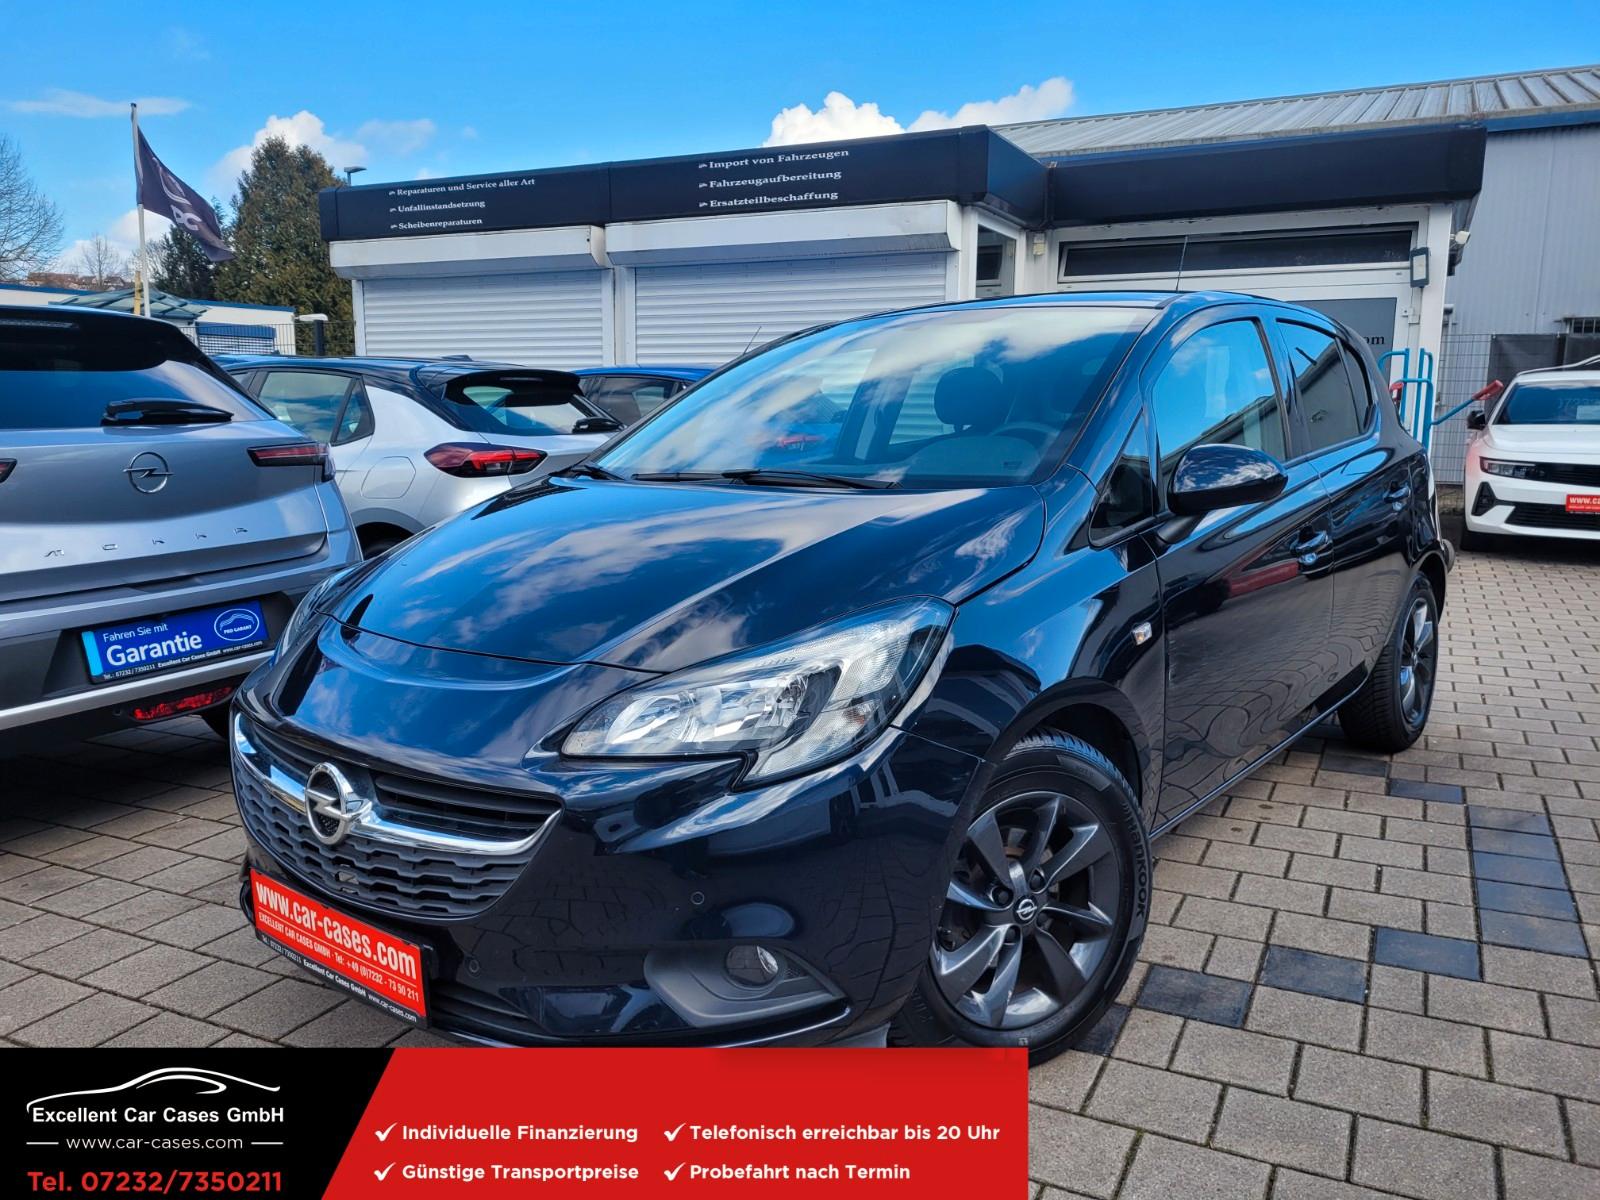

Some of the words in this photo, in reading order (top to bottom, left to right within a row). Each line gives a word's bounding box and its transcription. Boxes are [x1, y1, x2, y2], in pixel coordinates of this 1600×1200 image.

[709, 158, 749, 169] Import
[752, 157, 774, 165] von
[778, 150, 849, 162] Fahrzeugen
[397, 186, 446, 196] Reparaturen
[447, 183, 464, 191] und
[466, 181, 497, 190] Service
[499, 179, 519, 187] aller
[520, 178, 535, 186] Art
[709, 171, 842, 188] Fahrzeugaufbereitung
[398, 201, 486, 213] Unfallinstandsetzung
[710, 192, 839, 208] Ersatzteilbeschaffung
[398, 218, 483, 230] Scheibenreparaturen
[102, 629, 136, 643] Fahren
[136, 626, 152, 636] Sie
[153, 623, 168, 633] mit
[106, 631, 203, 666] Garantie
[256, 881, 417, 980] www.car-cases.com
[258, 911, 285, 933] EXCELLENT
[284, 926, 296, 940] CAR
[295, 932, 314, 949] CASES
[388, 978, 397, 992] 73
[397, 983, 407, 997] 50
[406, 988, 419, 1003] 211
[303, 959, 325, 977] Excellent
[325, 970, 335, 980] Car
[350, 983, 367, 998] GmbH
